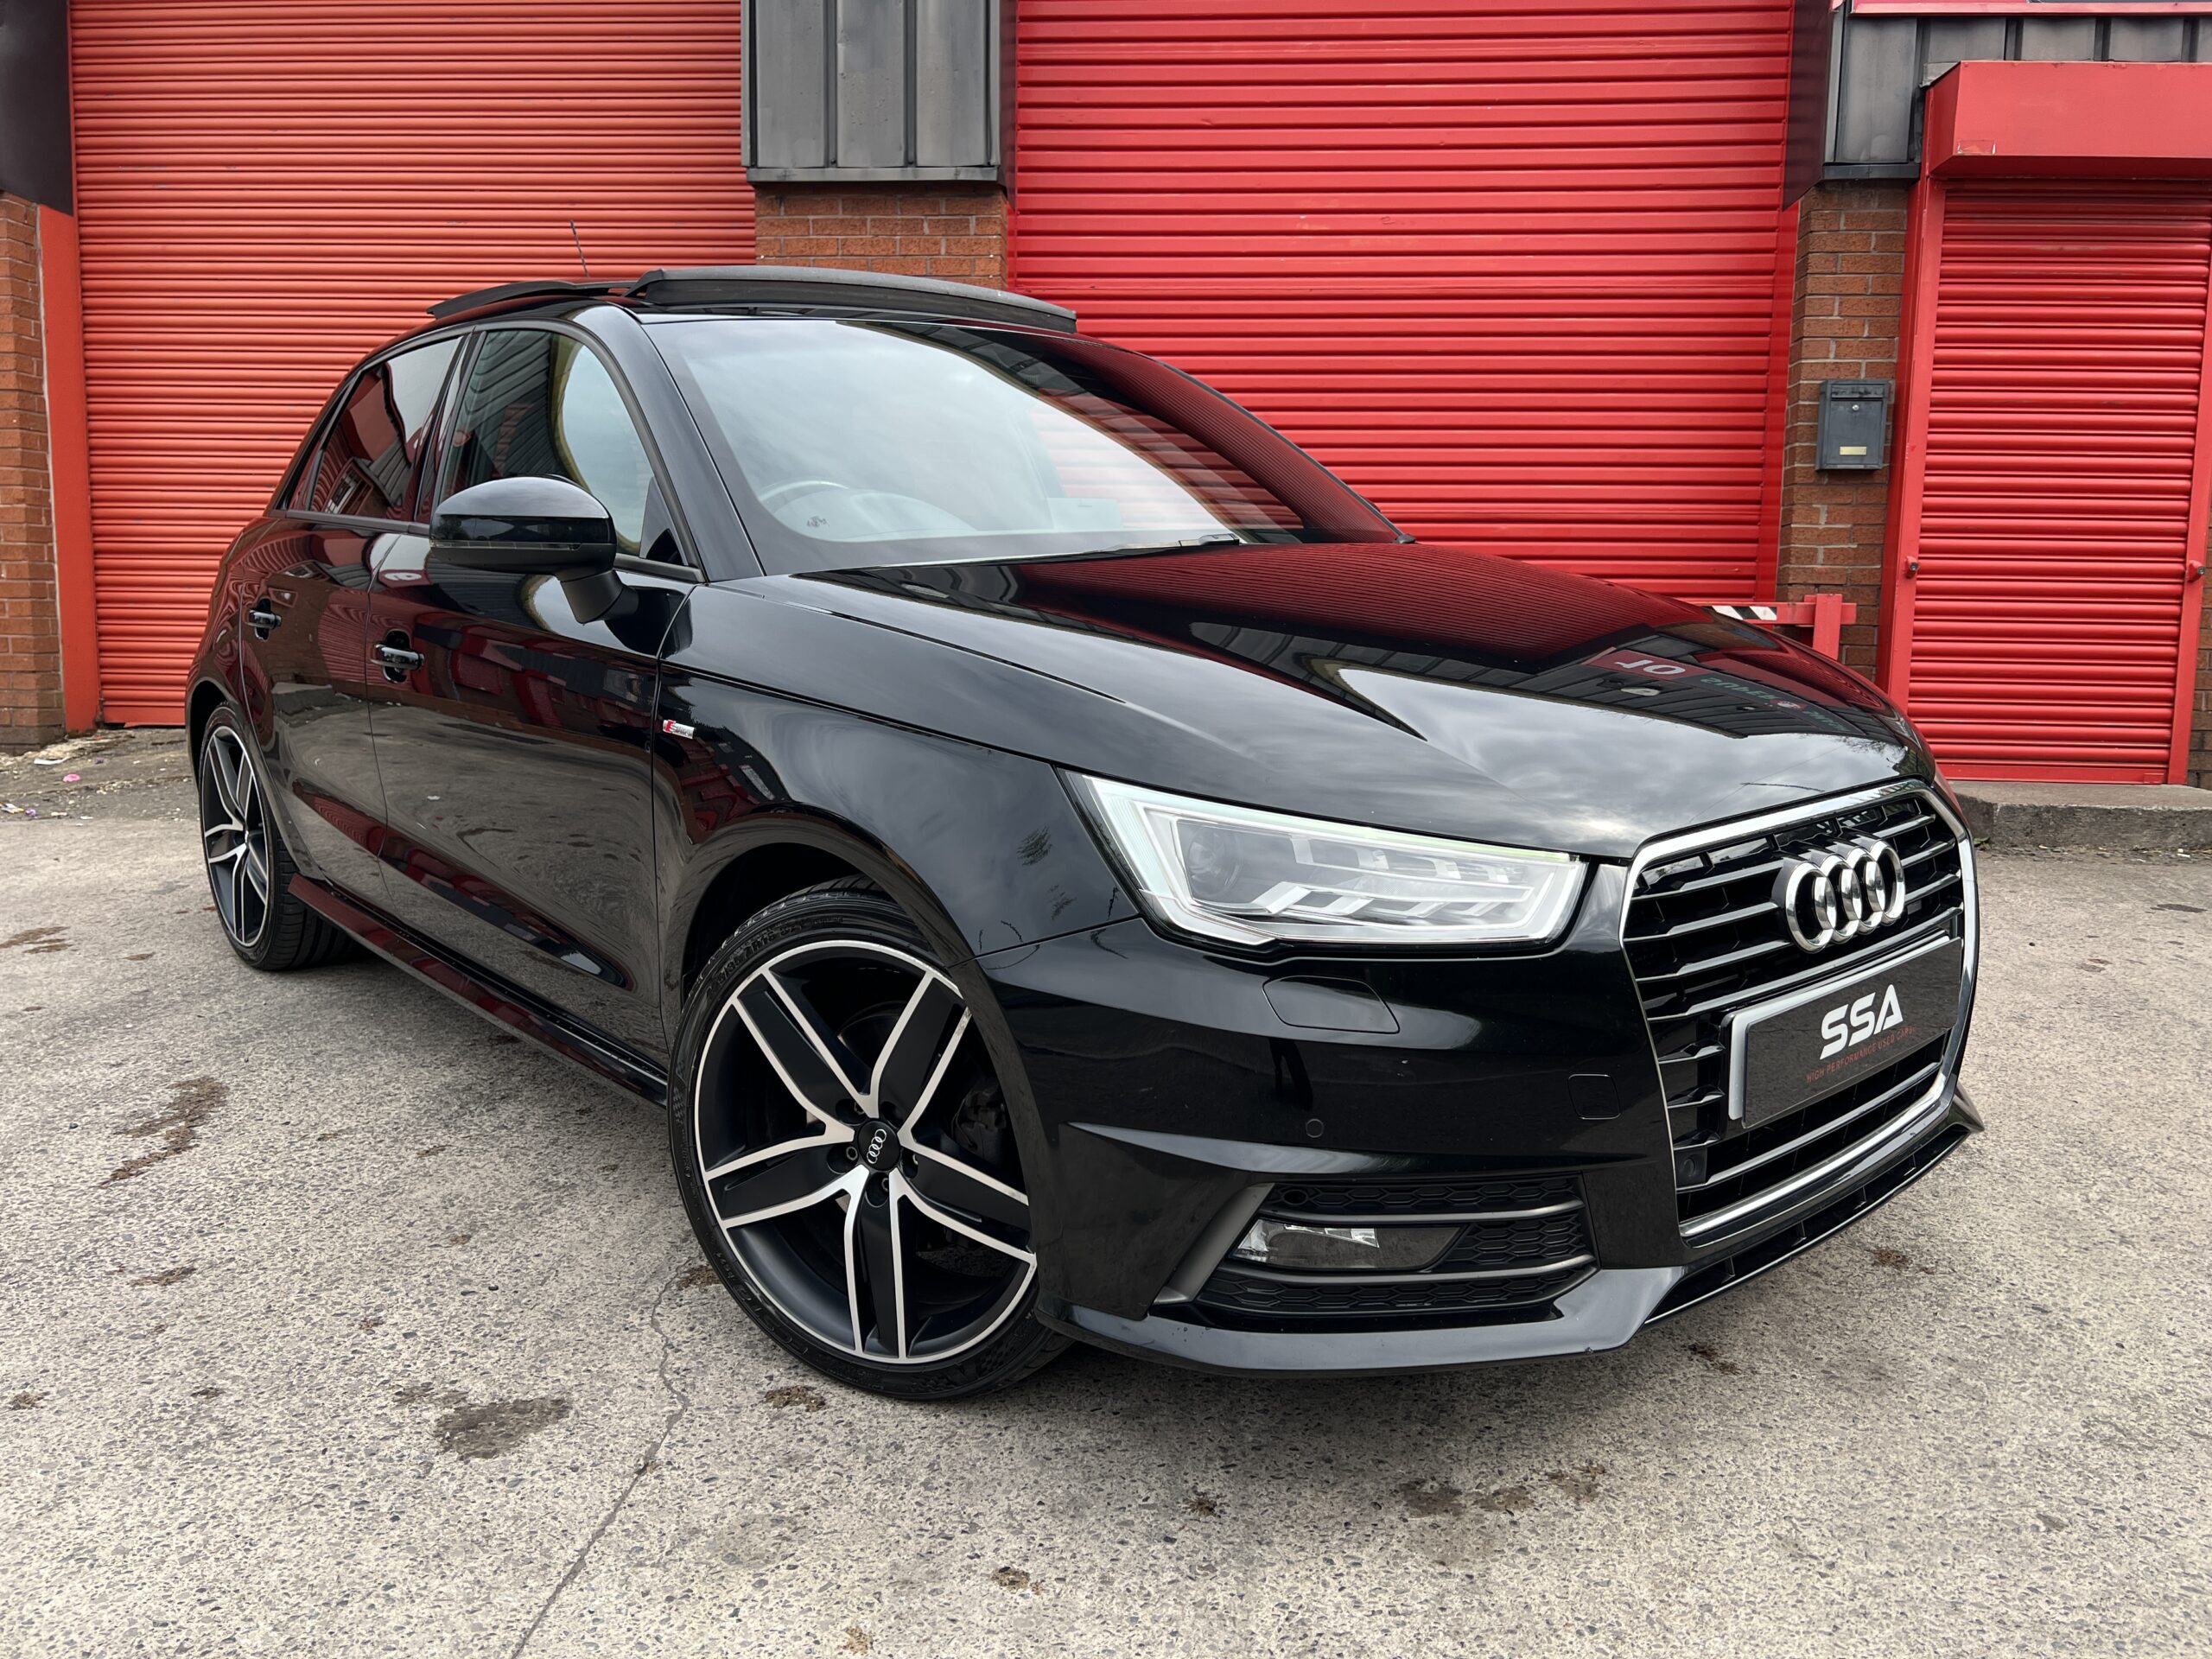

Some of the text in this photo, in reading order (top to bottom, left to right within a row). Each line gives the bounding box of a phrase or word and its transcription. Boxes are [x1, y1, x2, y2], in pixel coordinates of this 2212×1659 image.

[1820, 983, 1904, 1060] SSA
[1806, 1069, 1825, 1084] HIGH
[1827, 1042, 1877, 1075] PERFORMANCE
[1878, 1033, 1896, 1049] USED
